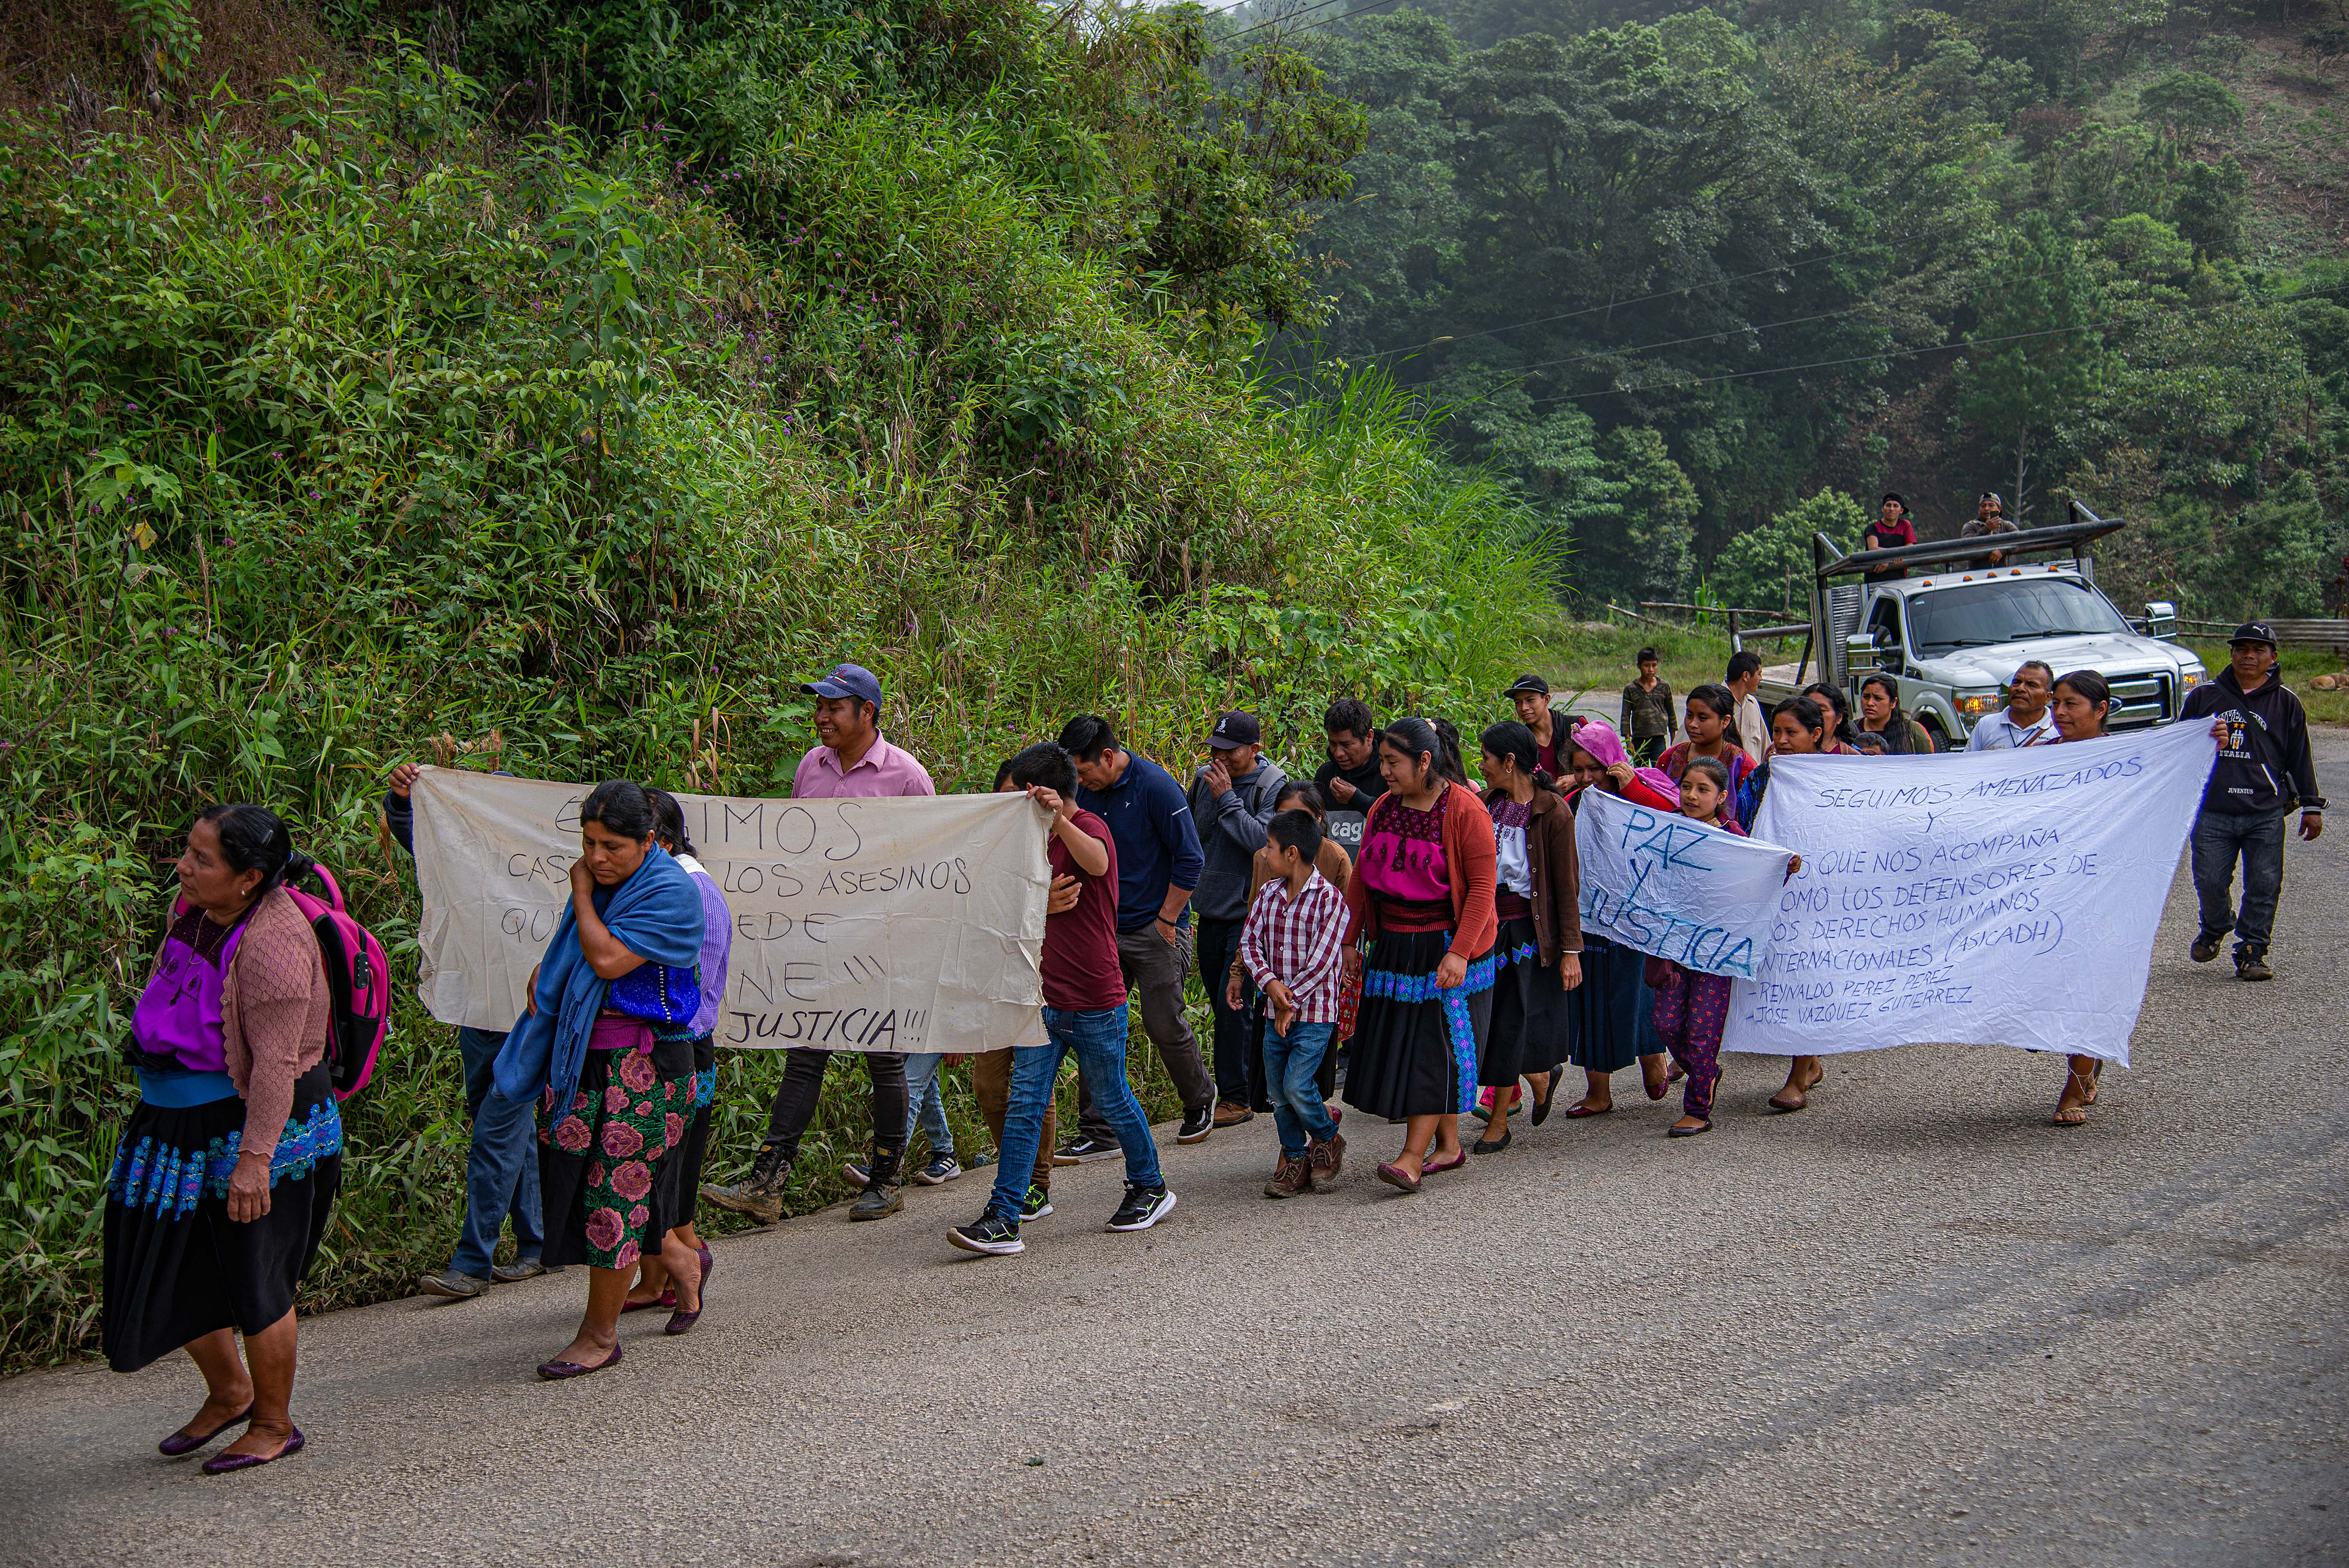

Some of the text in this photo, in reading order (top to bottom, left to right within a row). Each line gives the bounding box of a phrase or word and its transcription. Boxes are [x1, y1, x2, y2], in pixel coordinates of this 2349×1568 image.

[2219, 750, 2251, 759] ITALIA
[1815, 756, 2142, 809] SEGUIMOS AMENAZADOS
[1622, 808, 1712, 871] PAZ
[1926, 807, 1952, 833] Y
[1819, 850, 1867, 876] QUE
[1873, 847, 1921, 873] NOS
[1929, 827, 2059, 866] ACOMPAÑA
[723, 861, 804, 897] LOS
[817, 857, 971, 896] ASESINOS
[1629, 858, 1653, 904] Y
[1781, 853, 2098, 912] OMO LOS DEFENSORES DE
[1580, 888, 1753, 977] JUSTICIA
[1770, 887, 2040, 942] OS DERECHOS HUMANOS
[1944, 910, 2064, 963] (ASICADH)
[1798, 1002, 1872, 1024] VAZQUEZ
[1879, 985, 1973, 1012] GUTIERREZ
[1842, 978, 1897, 997] PEREZ
[1903, 965, 1954, 991] PEREZ
